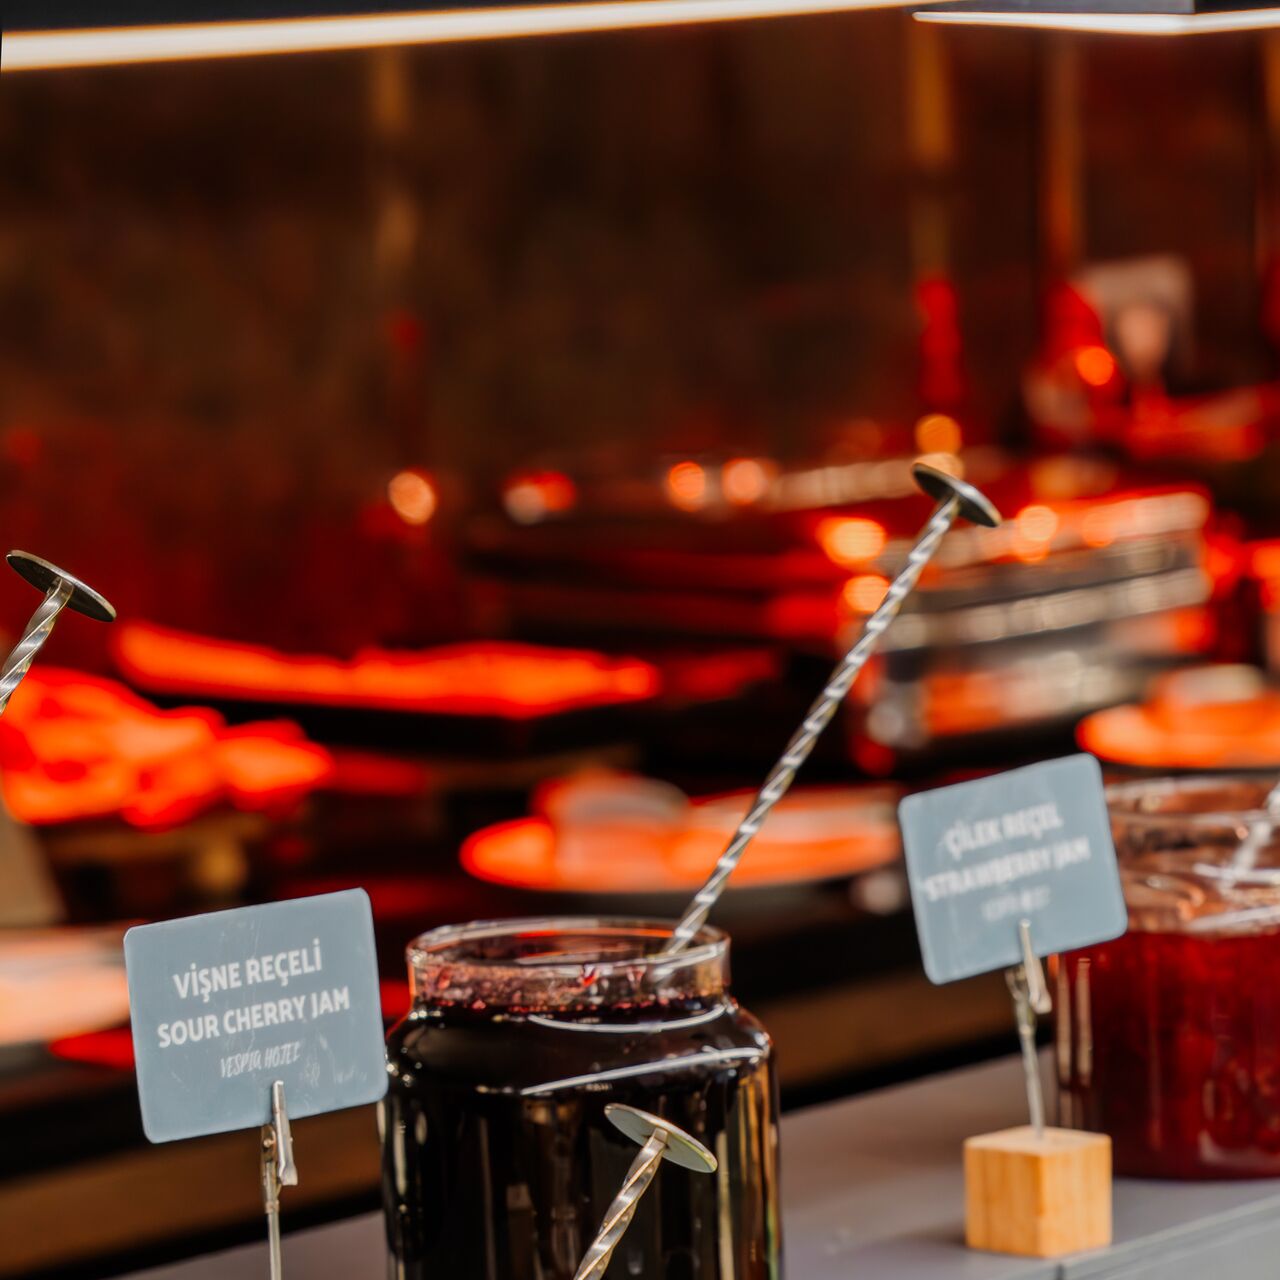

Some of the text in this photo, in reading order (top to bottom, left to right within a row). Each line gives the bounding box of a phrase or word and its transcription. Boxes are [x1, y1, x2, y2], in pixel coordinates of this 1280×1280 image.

[1052, 836, 1091, 869] JAM
[172, 938, 322, 1003] VİŞNE REÇELİ
[157, 986, 350, 1048] SOUR CHERRY JAM
